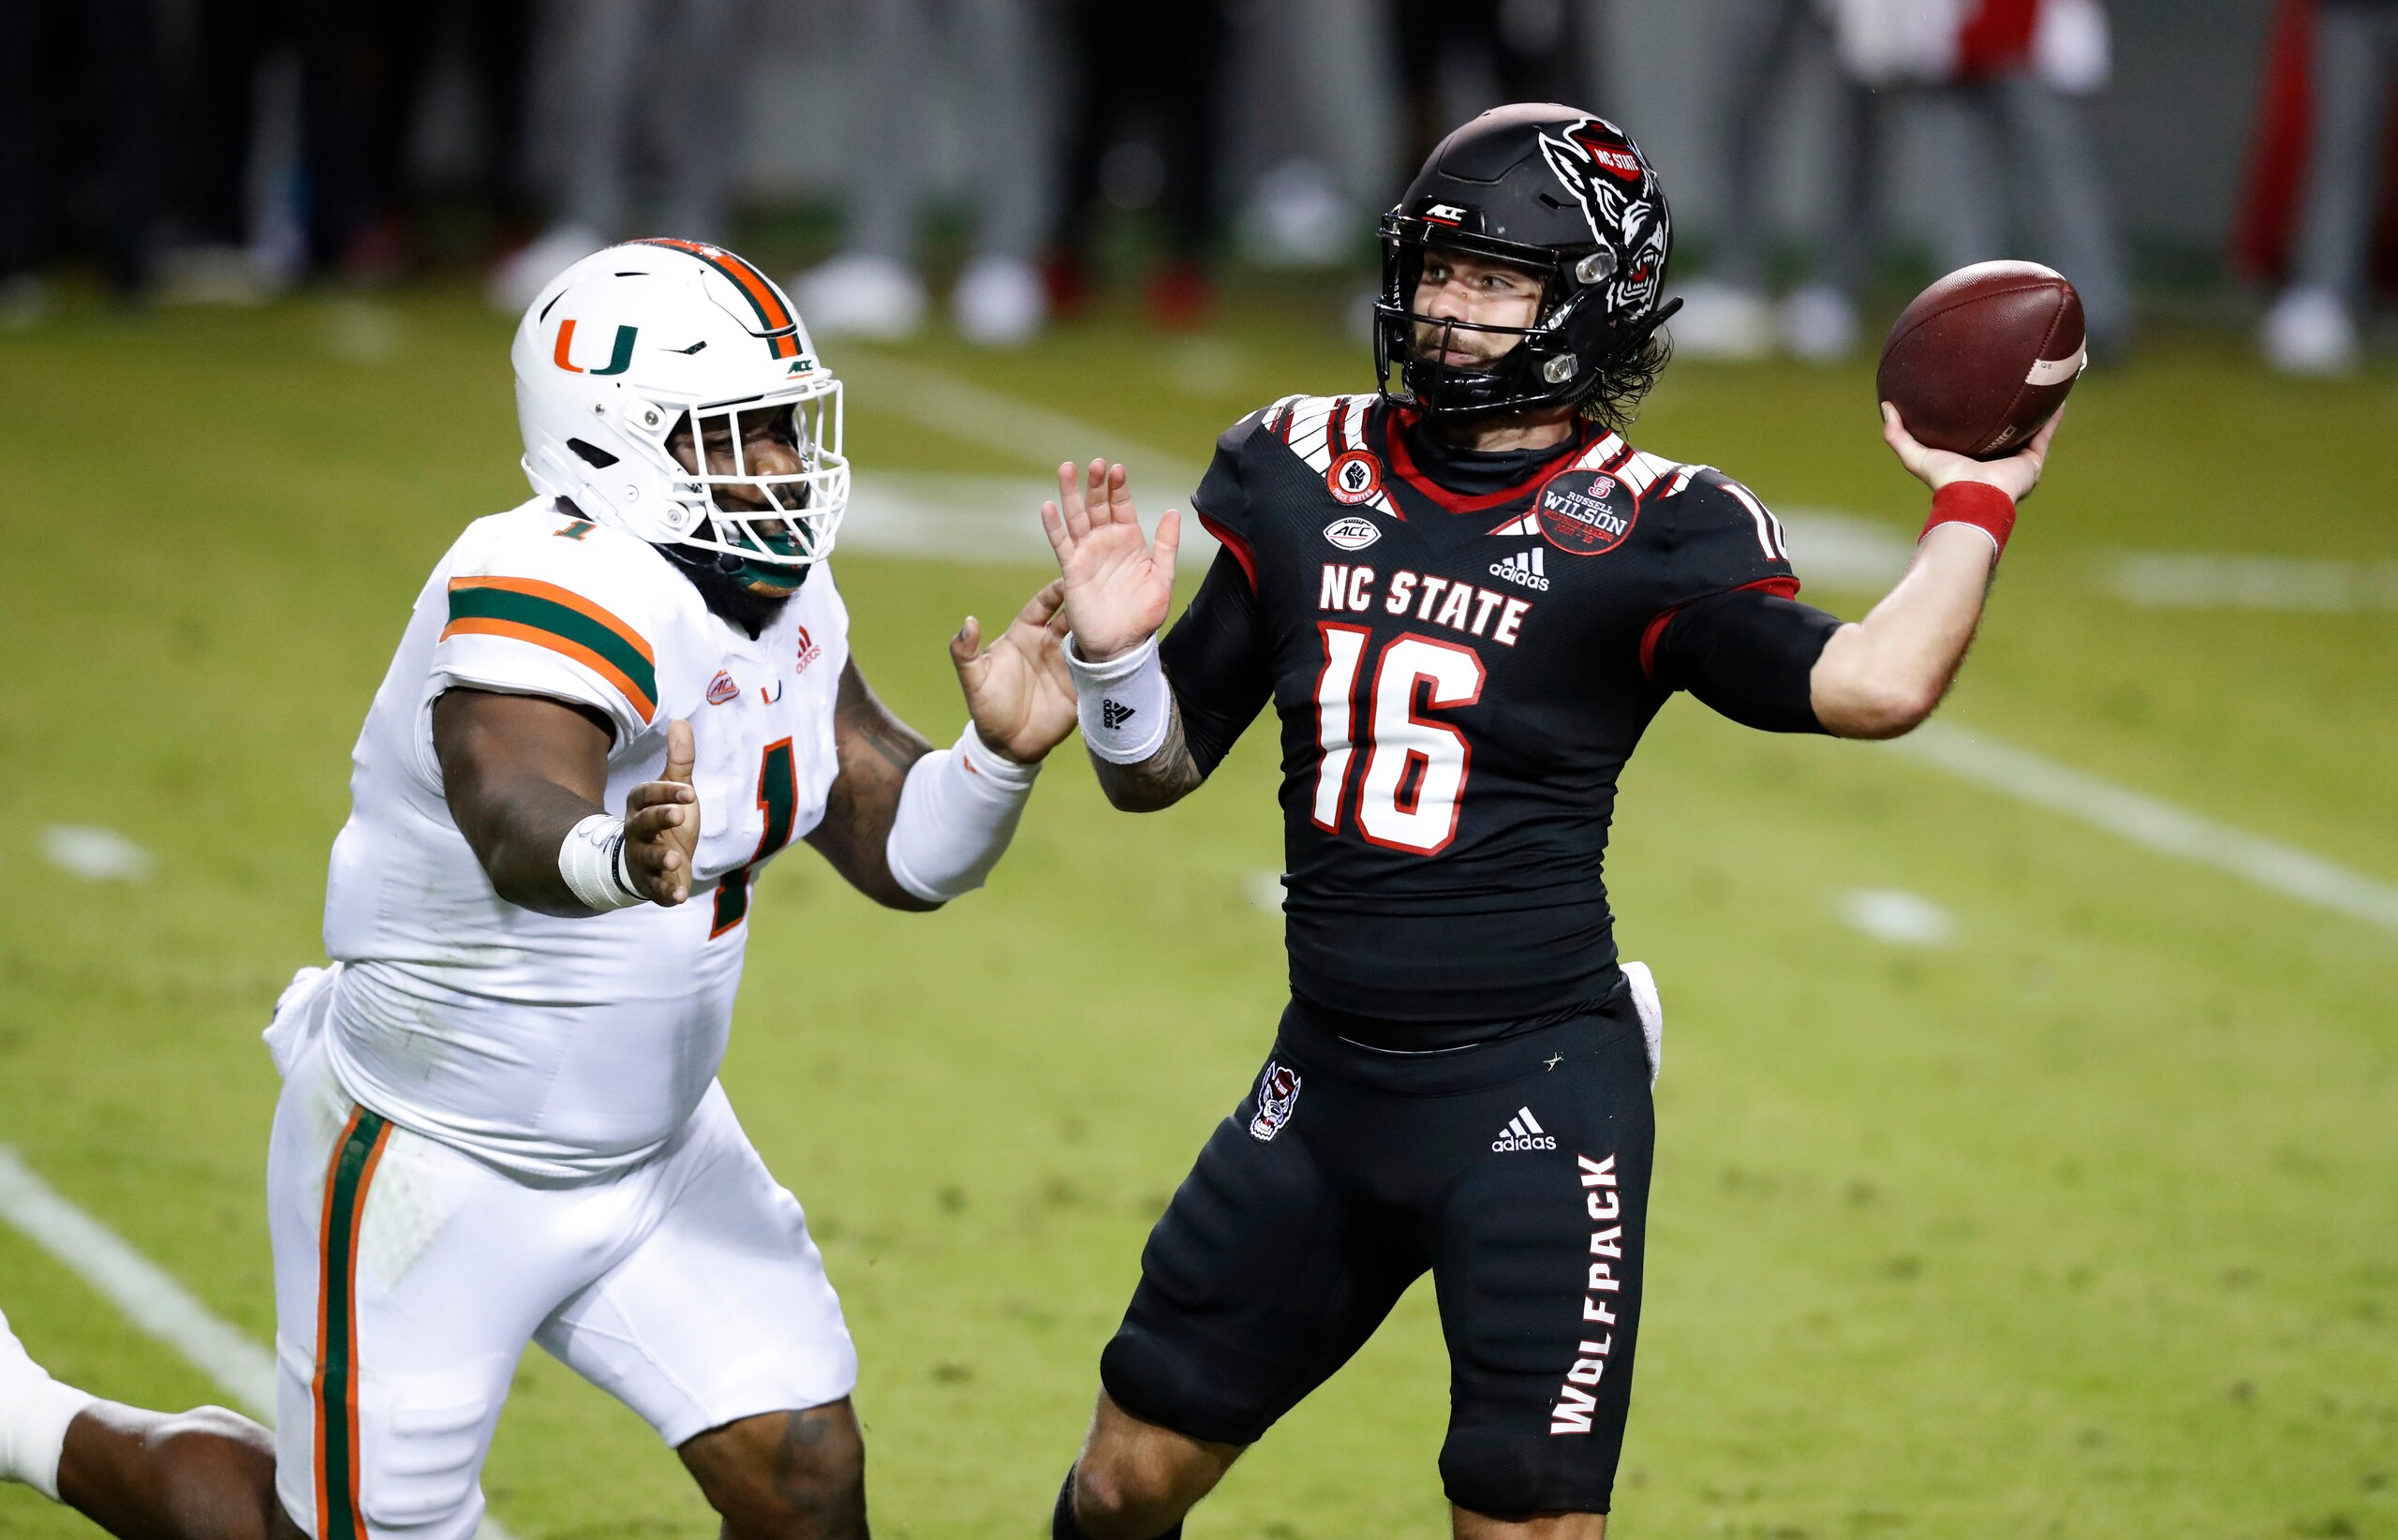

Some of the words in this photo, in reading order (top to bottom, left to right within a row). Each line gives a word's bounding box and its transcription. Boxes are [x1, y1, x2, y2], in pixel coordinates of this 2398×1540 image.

[1593, 148, 1614, 167] NC
[1612, 153, 1639, 170] STATE
[1426, 203, 1468, 221] ACC
[553, 318, 639, 376] U
[787, 360, 813, 375] ACC
[1349, 488, 1374, 503] UNITED
[1566, 491, 1613, 514] RUSSELL
[1544, 490, 1628, 536] WILSON
[1333, 526, 1372, 537] ACC
[1488, 562, 1550, 591] adidas
[1318, 563, 1376, 613] NC
[1384, 570, 1534, 647] STATE
[1103, 699, 1116, 729] adidas
[1311, 620, 1487, 857] 16
[707, 736, 799, 940] 1
[1491, 1133, 1557, 1153] adidas
[1548, 1152, 1622, 1437] WOLFPACK
